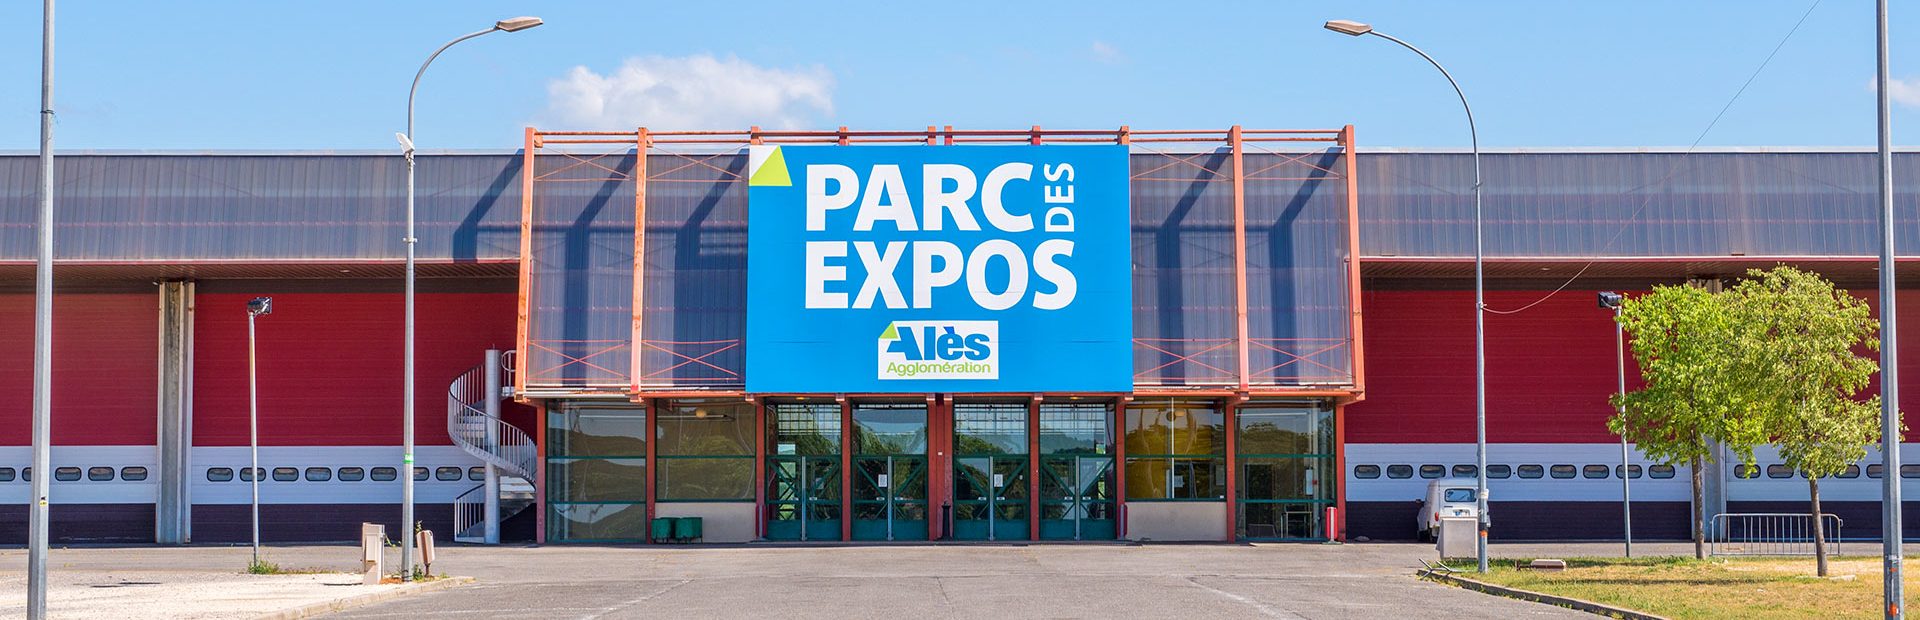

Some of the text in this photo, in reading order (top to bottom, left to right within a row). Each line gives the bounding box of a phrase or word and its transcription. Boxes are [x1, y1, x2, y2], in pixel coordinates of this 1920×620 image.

[806, 162, 1035, 232] PARC
[1043, 162, 1075, 232] DES
[805, 239, 1078, 311] EXPOS
[886, 326, 991, 361] Alès
[886, 361, 991, 377] Agglomération
